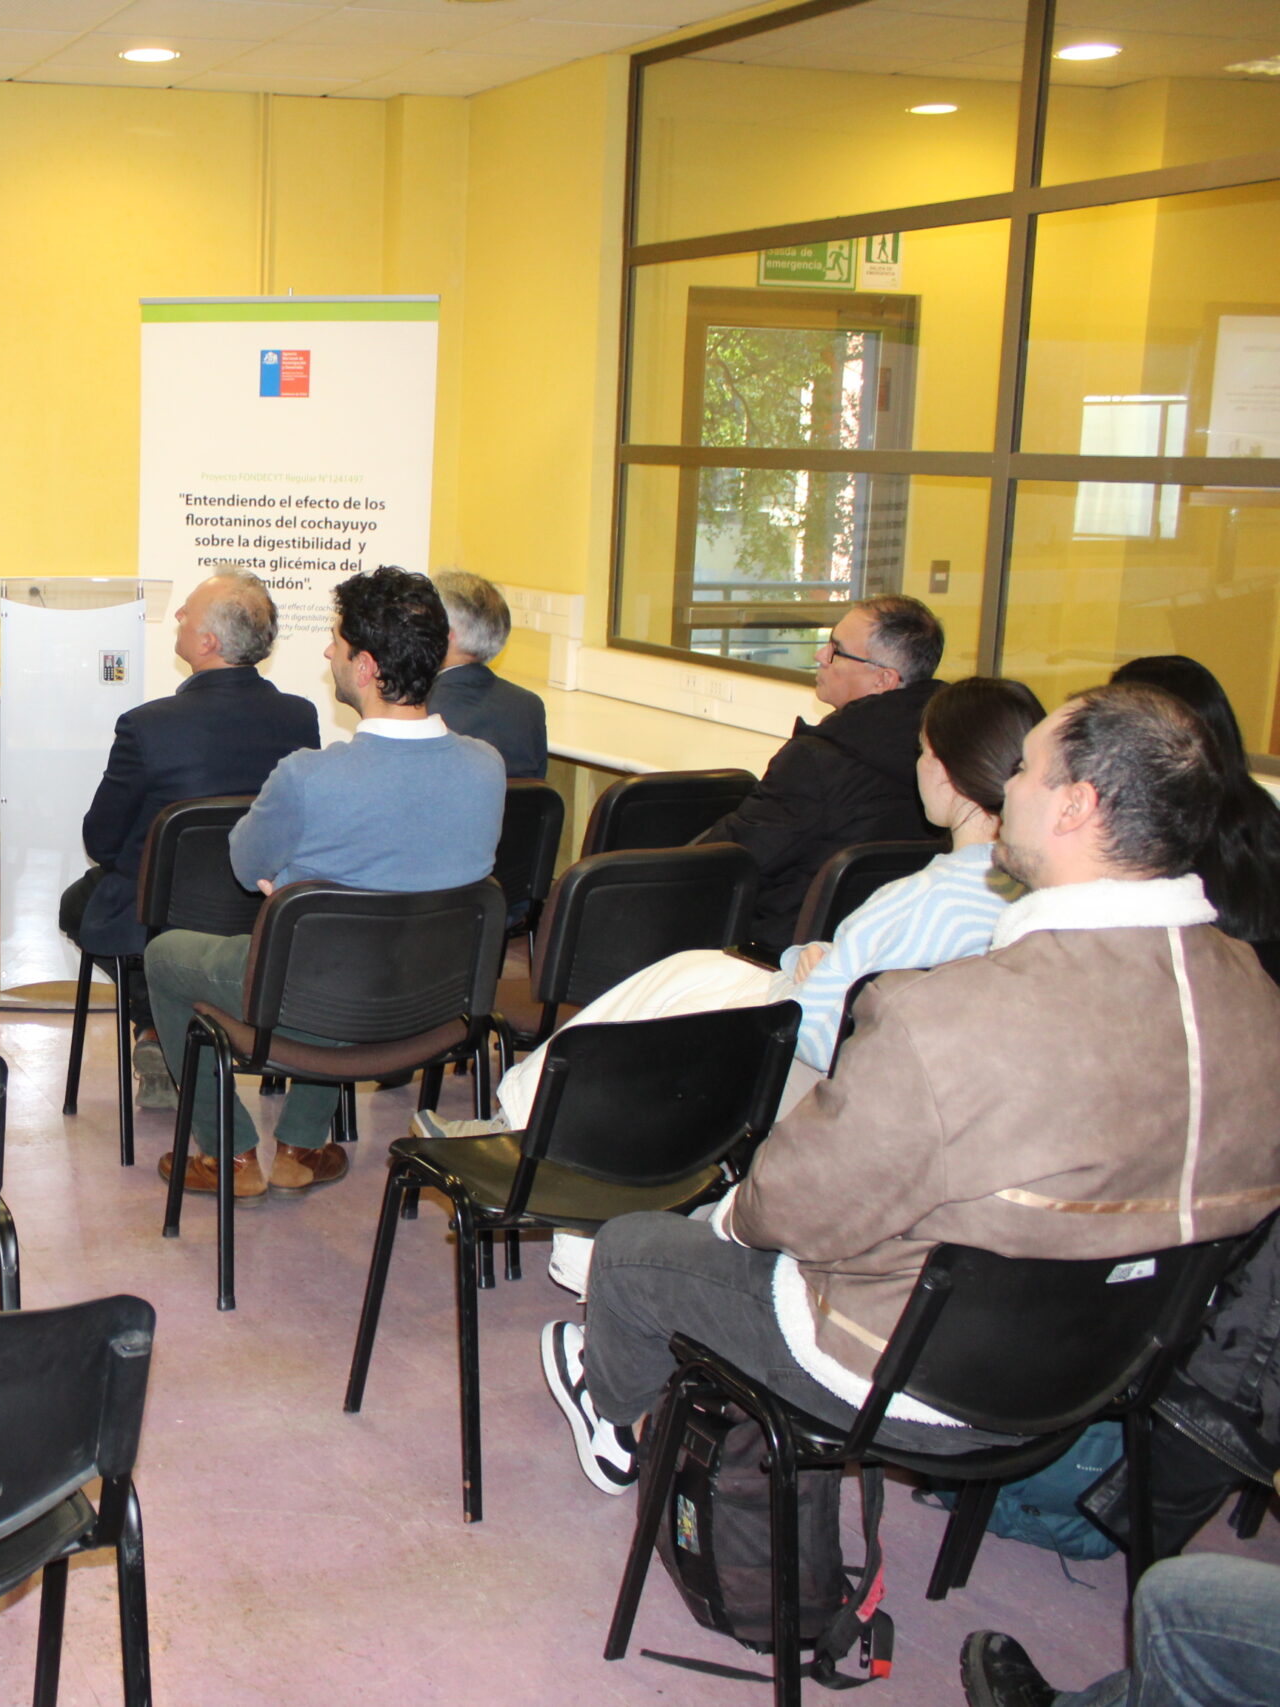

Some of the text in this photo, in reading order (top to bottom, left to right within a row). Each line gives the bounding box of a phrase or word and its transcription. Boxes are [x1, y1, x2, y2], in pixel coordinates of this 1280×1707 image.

[801, 247, 813, 256] de
[766, 259, 822, 272] emergencia
[201, 472, 237, 483] Proyecto
[239, 473, 282, 482] FONDECYT
[179, 493, 386, 510] "Entendiendo el efecto de los
[186, 513, 377, 533] florotaninos del cochayuyo
[195, 535, 367, 554] sobre la digestibilidad y
[270, 557, 336, 573] glicémica
[340, 559, 362, 571] del
